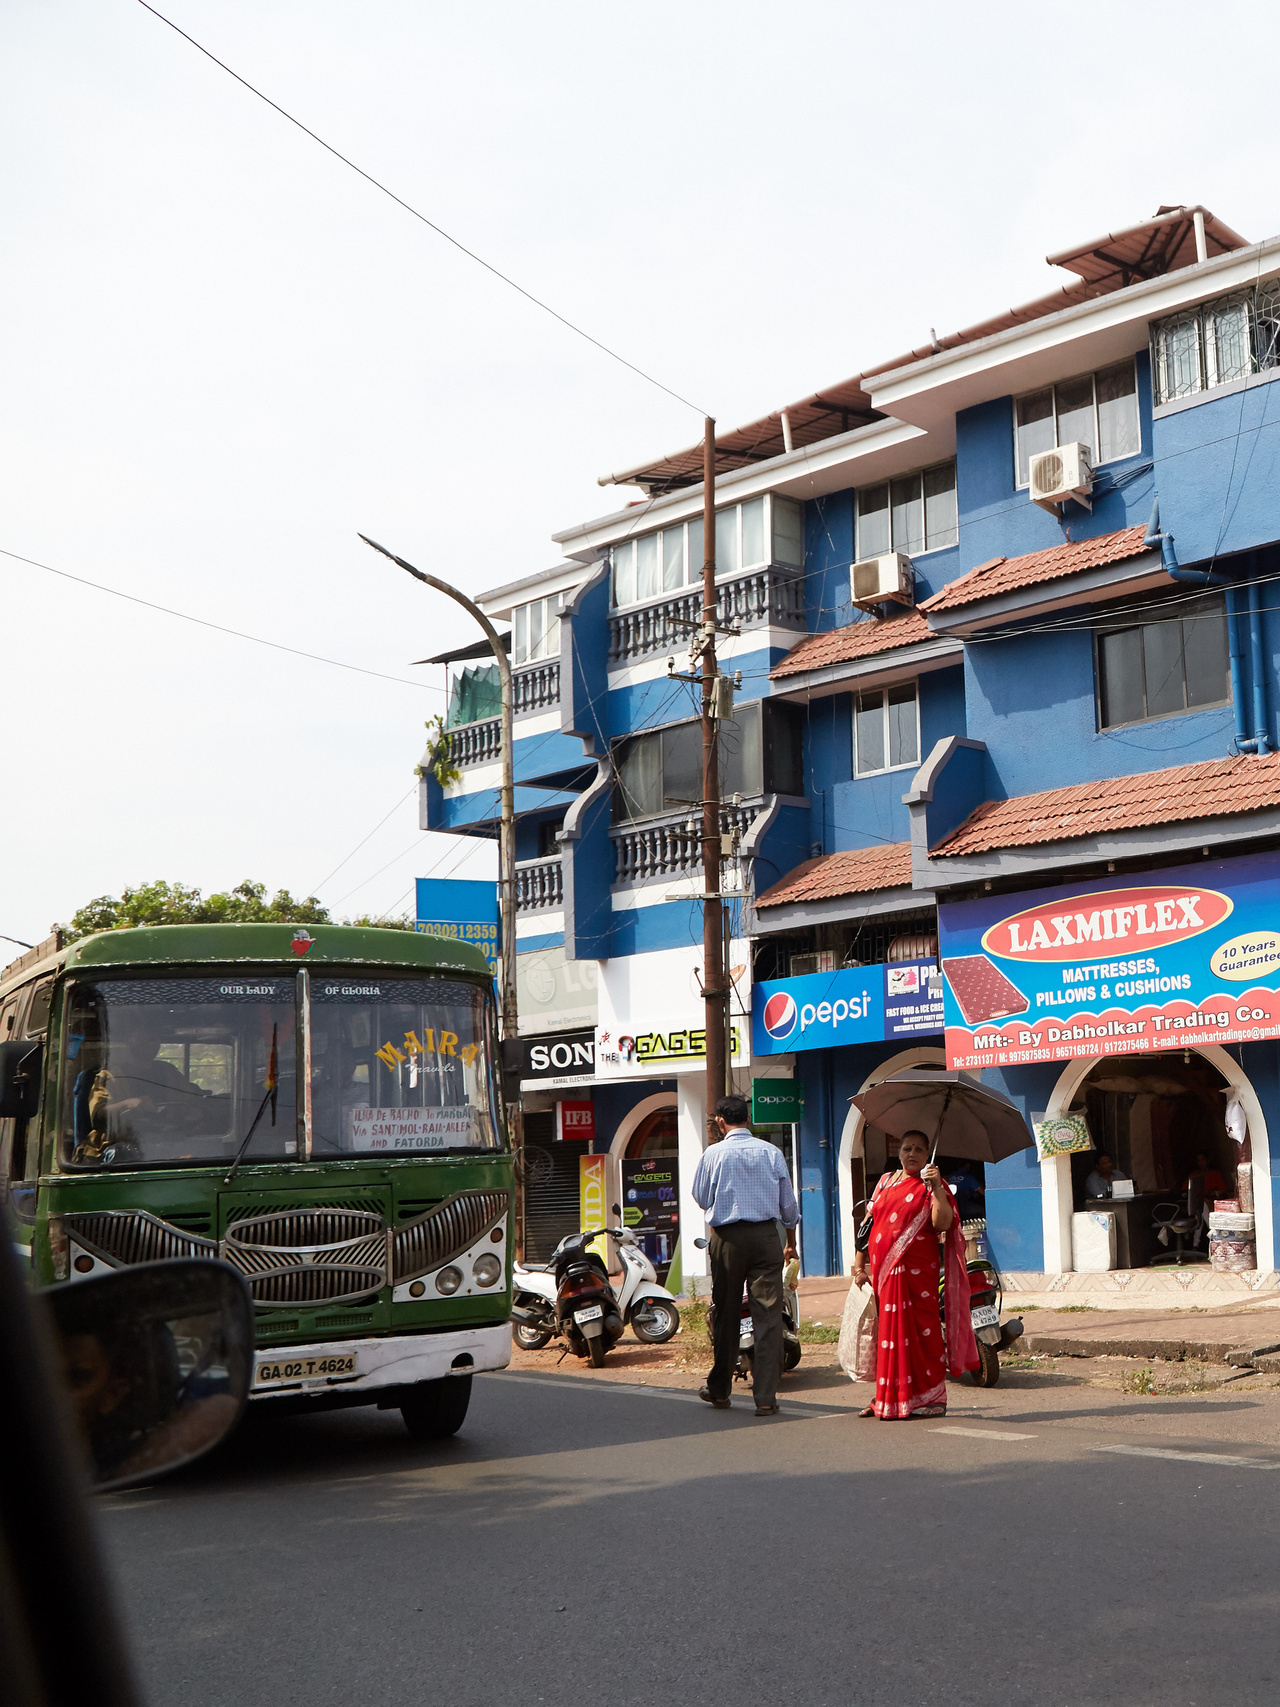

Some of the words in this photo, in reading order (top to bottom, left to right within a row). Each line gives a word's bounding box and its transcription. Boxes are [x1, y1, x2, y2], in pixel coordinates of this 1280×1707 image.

[1007, 896, 1205, 953] LAXMIFLEX
[1222, 947, 1237, 959] 10
[1241, 939, 1276, 954] Years
[563, 960, 598, 993] LG
[1062, 957, 1160, 984] MATTRESSES,
[220, 986, 244, 995] OUR
[246, 986, 276, 995] LADY
[325, 987, 339, 995] OF
[341, 987, 381, 995] GLORIA
[1036, 988, 1096, 1007] PILLOWS
[1100, 987, 1111, 998] &
[1115, 974, 1191, 997] CUSHIONS
[801, 990, 868, 1032] pepsi
[886, 1008, 900, 1017] FAST
[900, 1006, 914, 1015] FOOD
[915, 1006, 919, 1014] &
[920, 1004, 929, 1013] ICE
[973, 1034, 1014, 1050] Mft:-
[1018, 1030, 1042, 1048] By
[1047, 1019, 1147, 1042] Dabholkar
[1151, 1011, 1230, 1031] Trading
[1236, 1006, 1271, 1022] Co.
[374, 1028, 479, 1072] MAIRA
[530, 1042, 595, 1070] SON
[600, 1053, 615, 1062] THE
[953, 1057, 964, 1067] Tel:
[965, 1053, 993, 1066] 2731137
[999, 1053, 1008, 1063] M:
[1009, 1048, 1050, 1062] 9975875835
[1056, 1043, 1098, 1058] 9657168724
[1105, 1038, 1149, 1053] 9172375466
[1152, 1035, 1178, 1048] E-mail:
[757, 1096, 795, 1104] oppo
[565, 1111, 592, 1126] IFB
[394, 1136, 444, 1148] FATORDA
[634, 1173, 671, 1182] GAGETS
[658, 1187, 675, 1201] 0%
